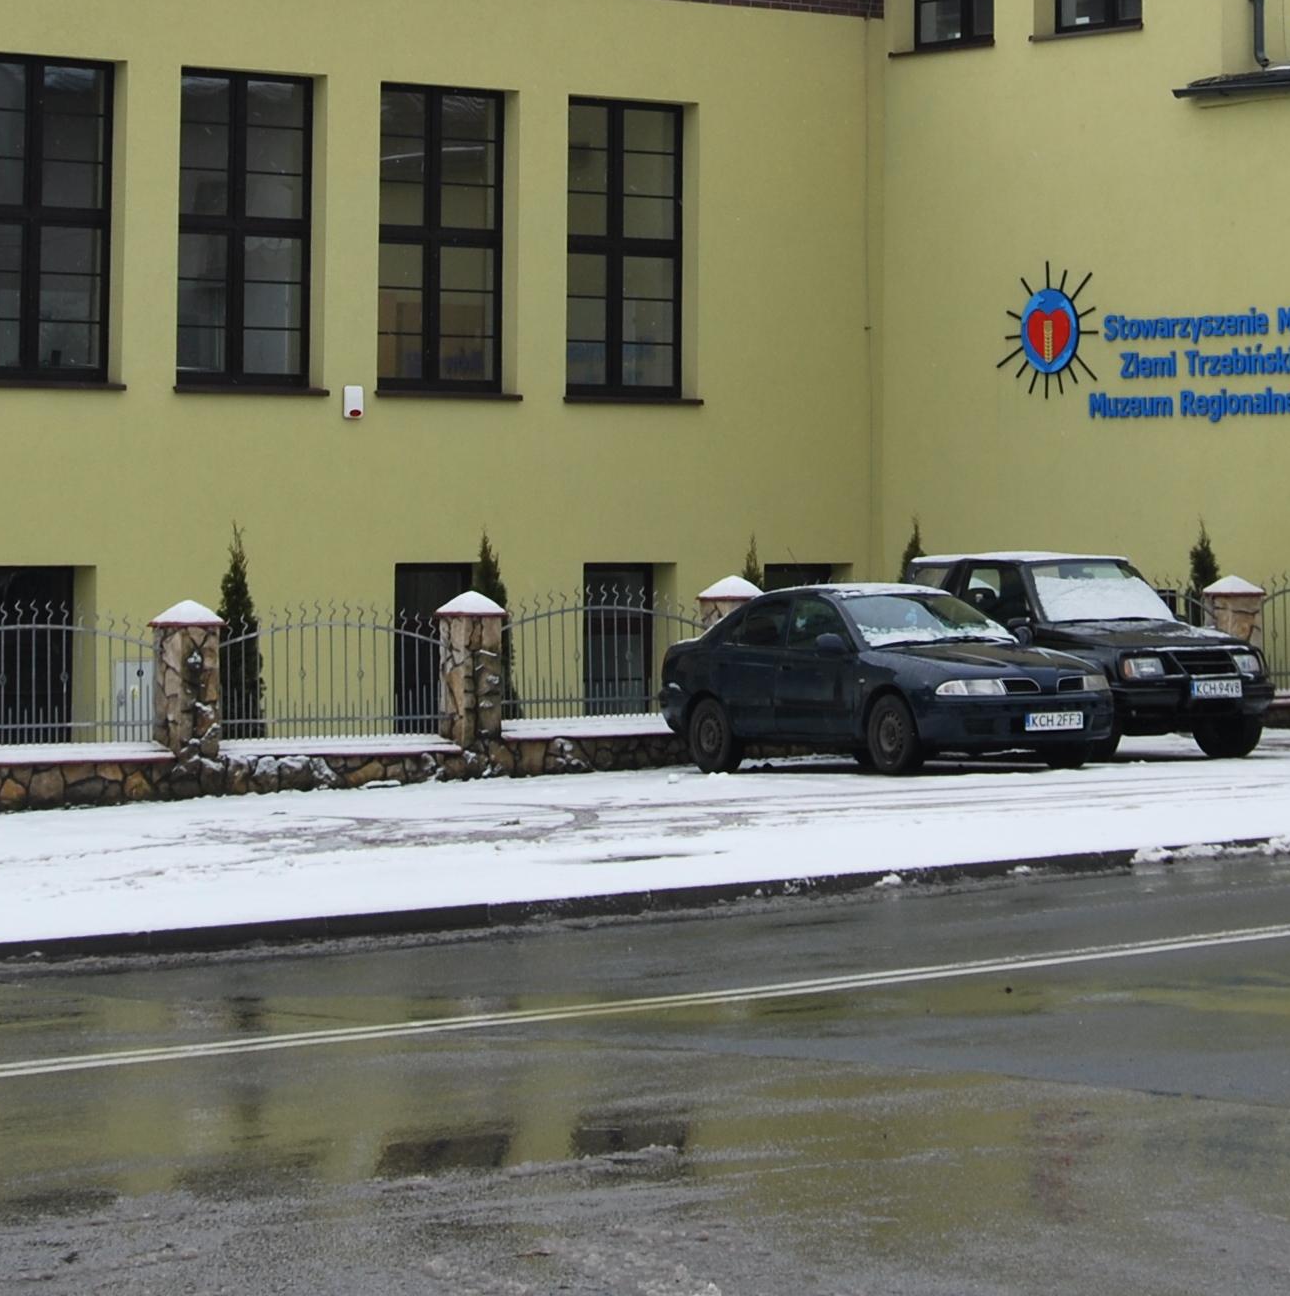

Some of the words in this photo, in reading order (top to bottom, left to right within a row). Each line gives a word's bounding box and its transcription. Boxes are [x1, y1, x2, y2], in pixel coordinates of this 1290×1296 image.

[1103, 307, 1269, 343] Stowarzyszenie
[1120, 350, 1177, 379] Ziemi
[1089, 392, 1173, 419] Muzeum
[1197, 684, 1217, 694] KCH
[1031, 715, 1054, 727] KCH
